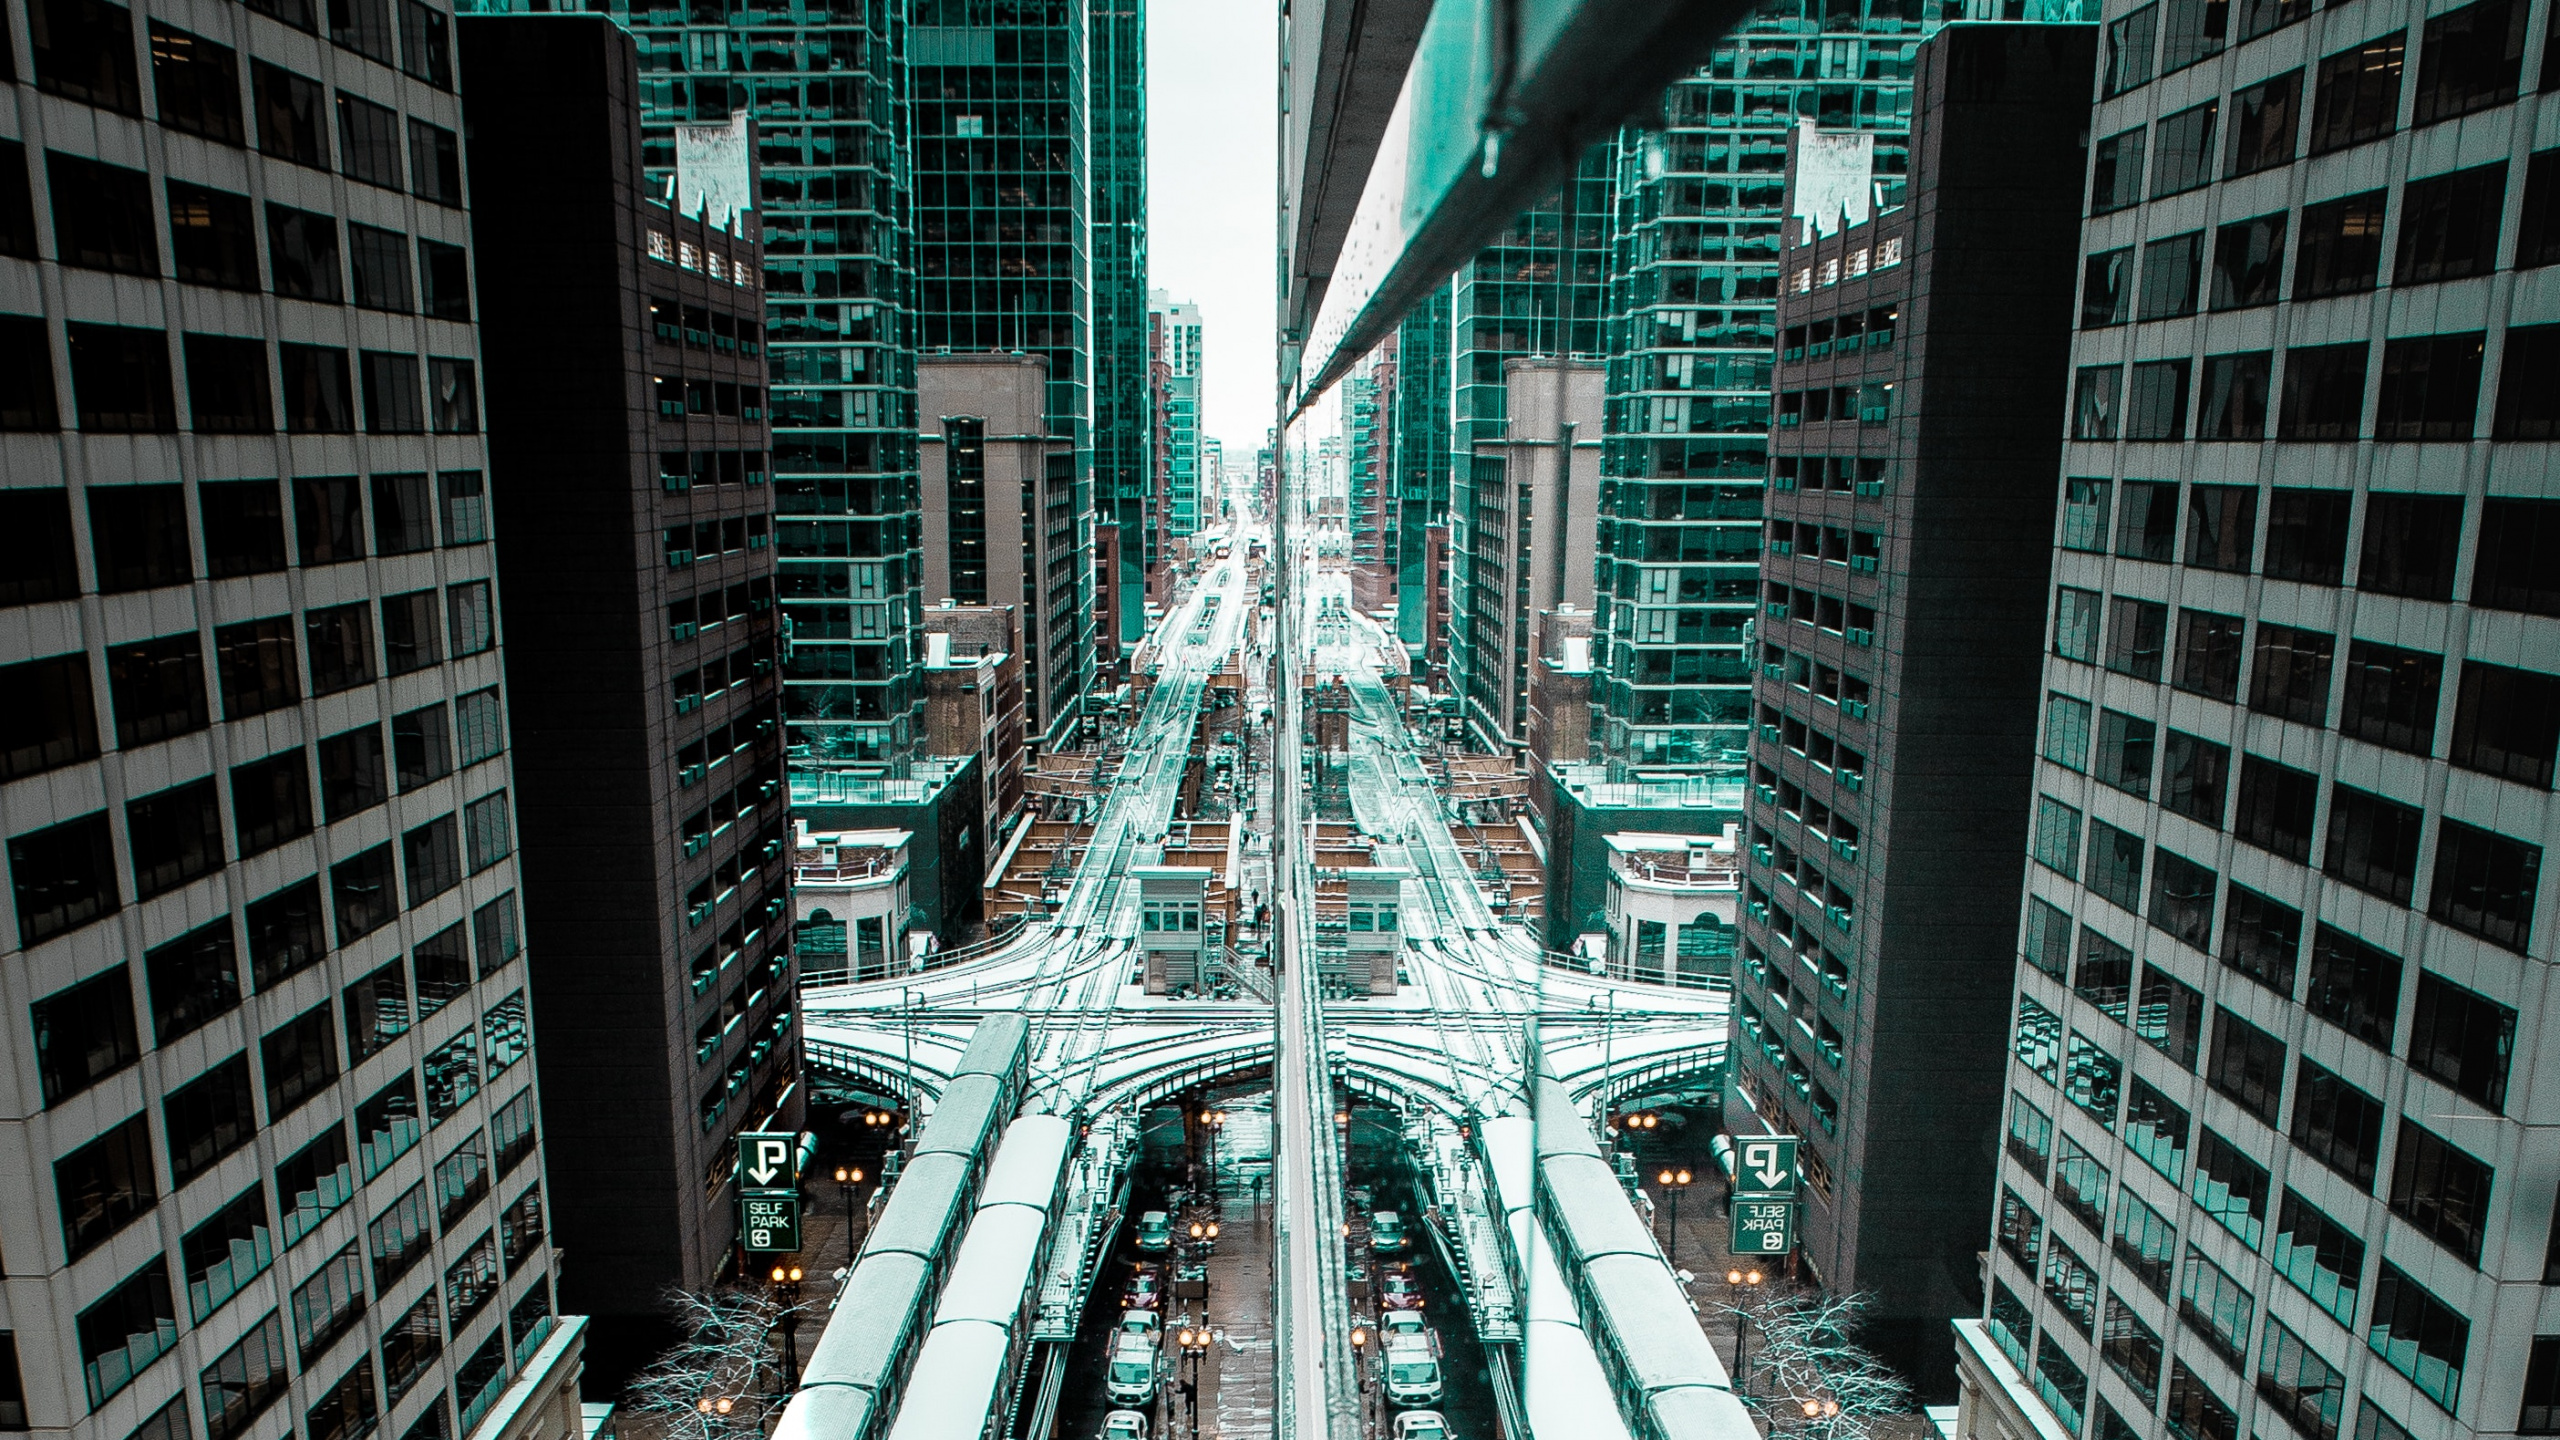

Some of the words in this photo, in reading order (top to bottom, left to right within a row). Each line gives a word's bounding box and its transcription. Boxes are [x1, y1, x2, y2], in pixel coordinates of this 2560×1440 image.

[754, 1140, 787, 1178] P
[750, 1202, 783, 1215] SELF
[750, 1215, 790, 1228] PARK
